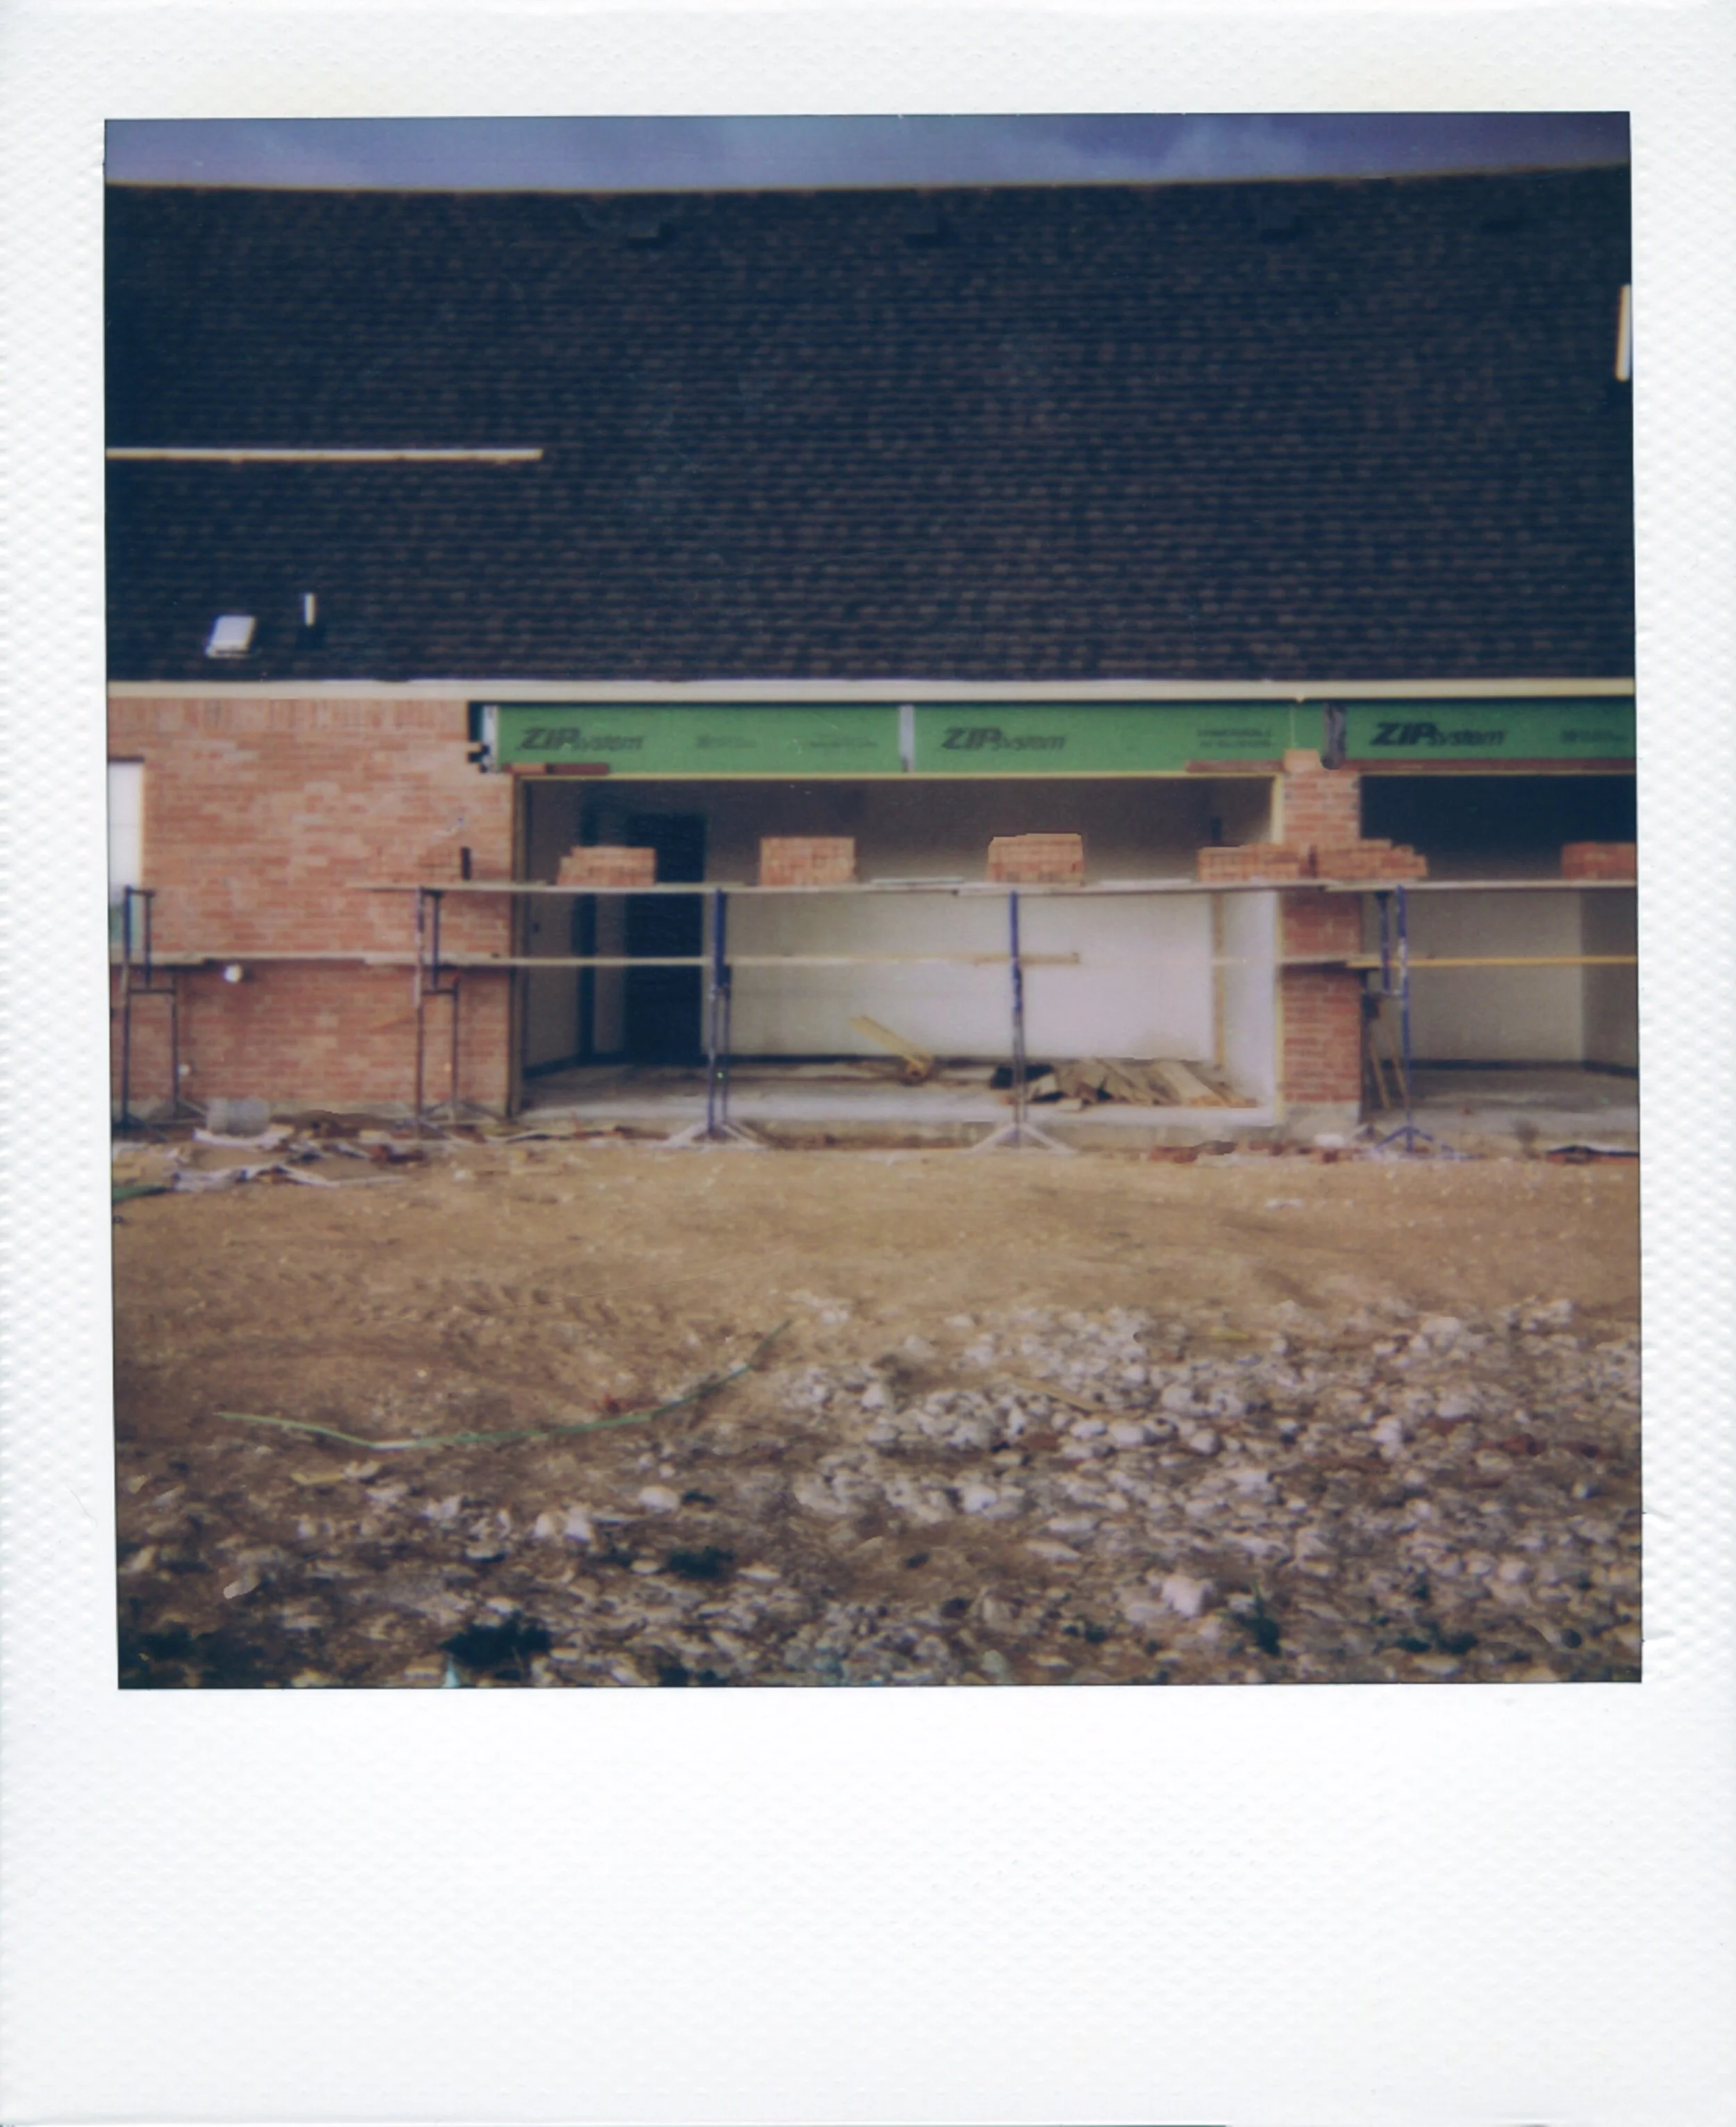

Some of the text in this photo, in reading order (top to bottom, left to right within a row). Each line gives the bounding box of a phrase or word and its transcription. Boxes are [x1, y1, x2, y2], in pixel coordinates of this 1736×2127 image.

[521, 727, 581, 750] ZIP
[942, 727, 1002, 750] ZIP
[1369, 722, 1437, 746] ZIP
